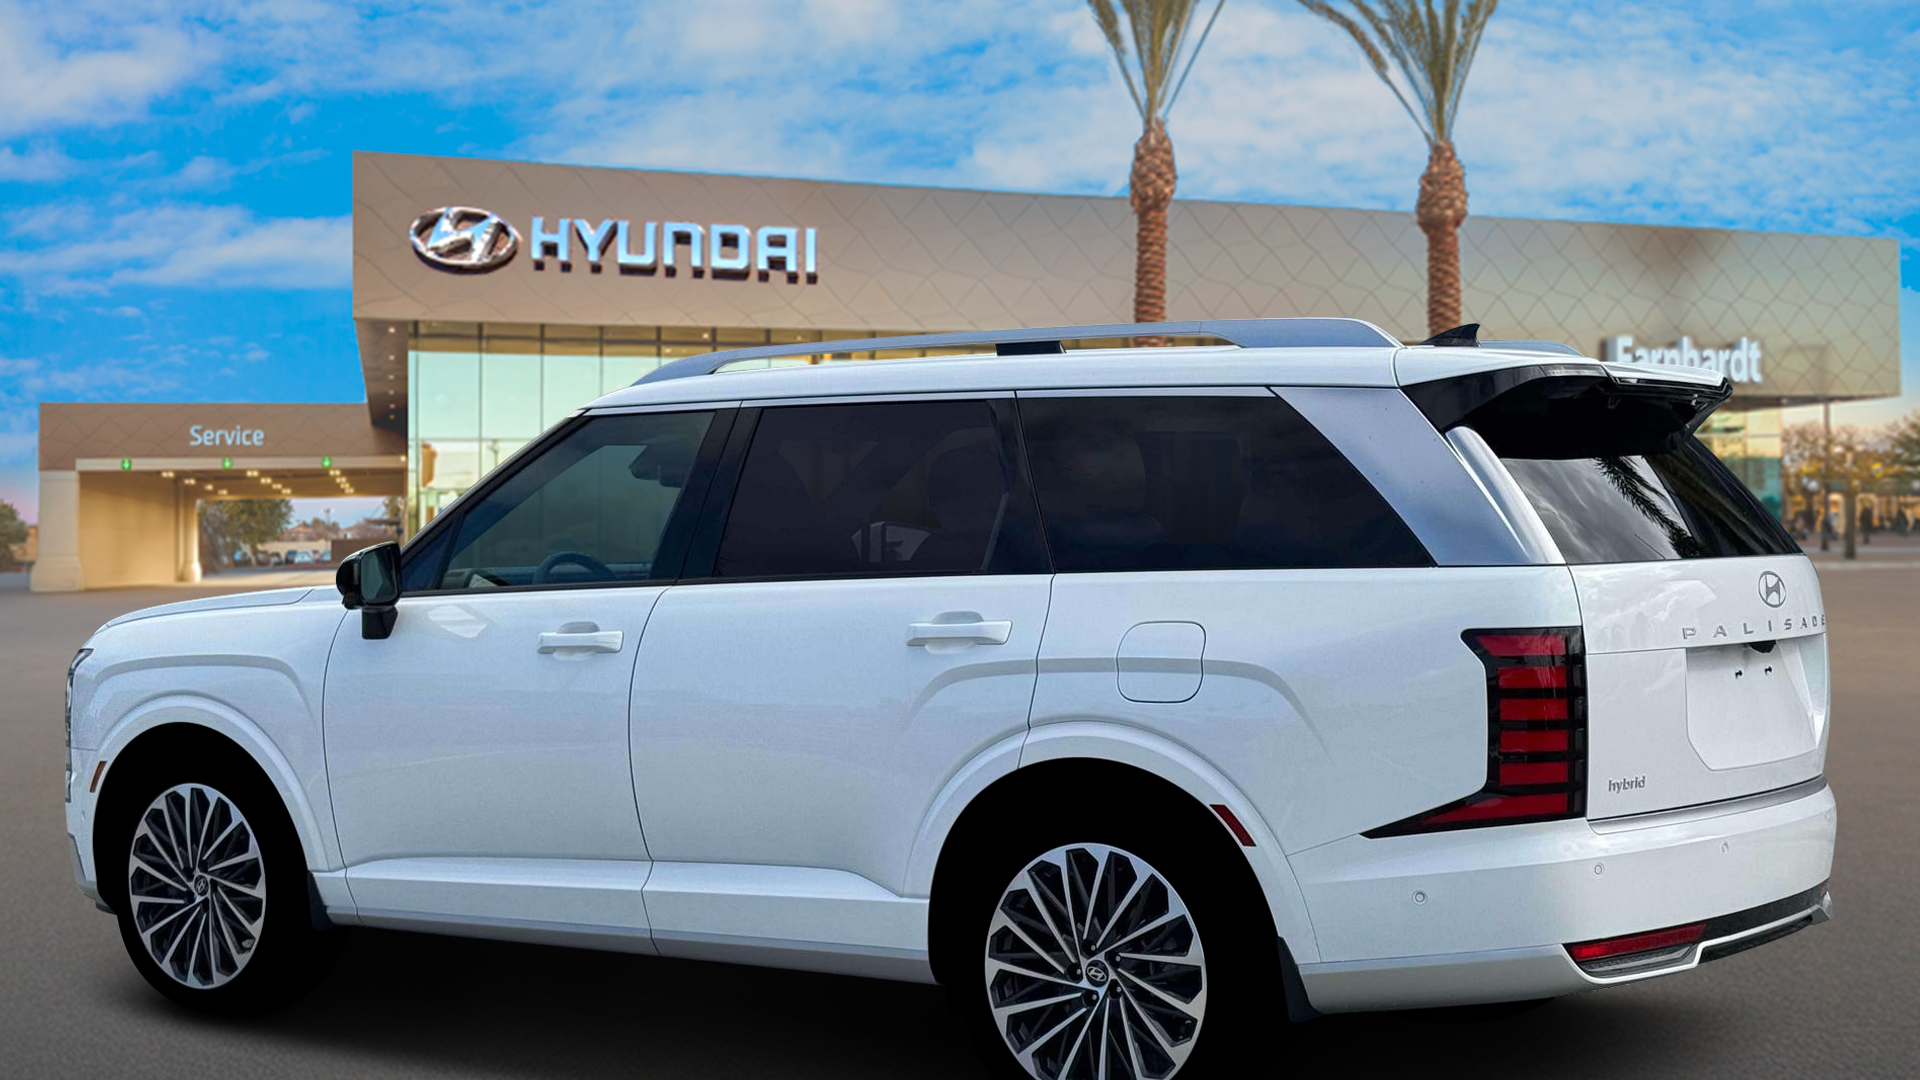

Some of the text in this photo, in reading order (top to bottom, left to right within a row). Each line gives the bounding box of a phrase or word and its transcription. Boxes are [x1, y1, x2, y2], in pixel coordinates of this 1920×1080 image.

[530, 216, 818, 282] HYUNDAI
[189, 424, 265, 447] Service
[1682, 614, 1826, 640] PALISADE
[1608, 775, 1646, 795] hybrid
